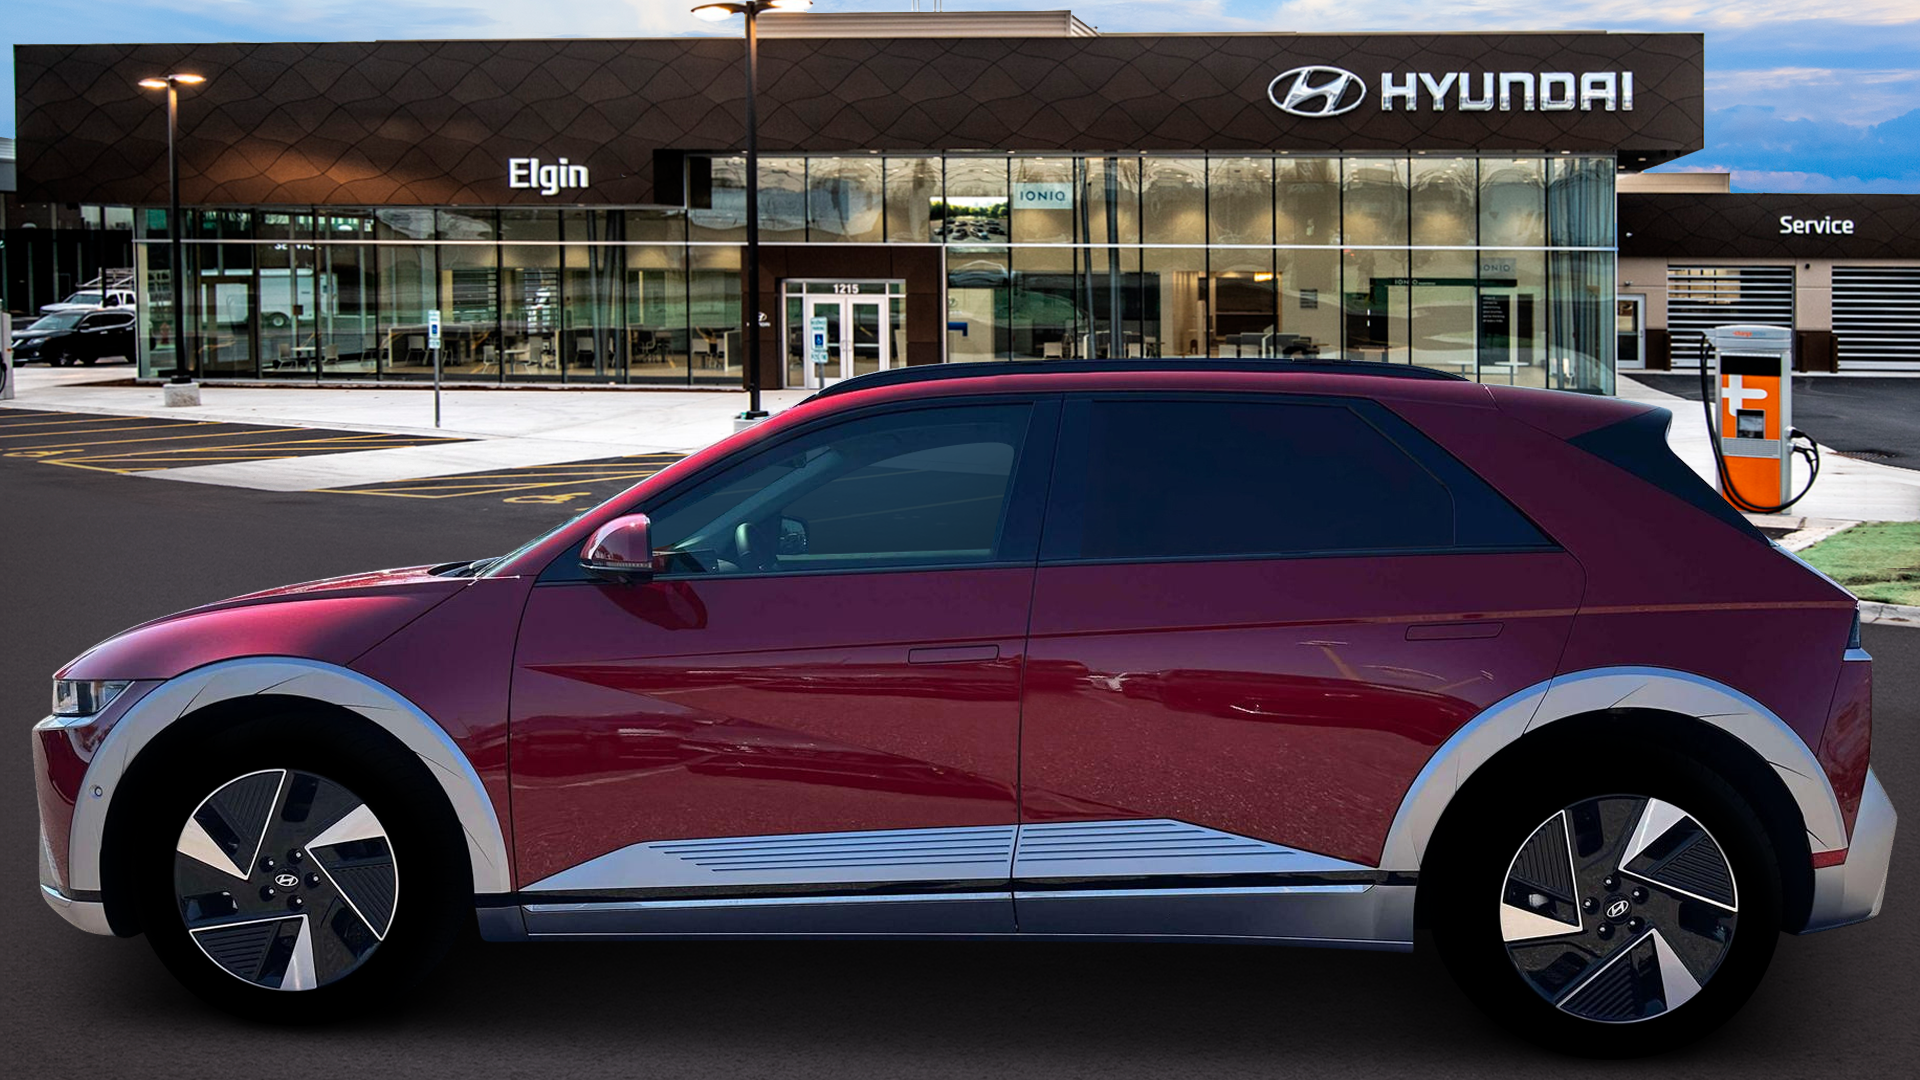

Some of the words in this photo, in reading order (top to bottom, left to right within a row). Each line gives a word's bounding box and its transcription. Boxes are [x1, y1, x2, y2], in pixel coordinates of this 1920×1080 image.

[1381, 72, 1633, 111] HYUNDAI
[509, 157, 589, 196] Elgin
[1020, 190, 1066, 202] IONIQ
[1779, 215, 1854, 235] Service
[833, 283, 859, 294] 1215
